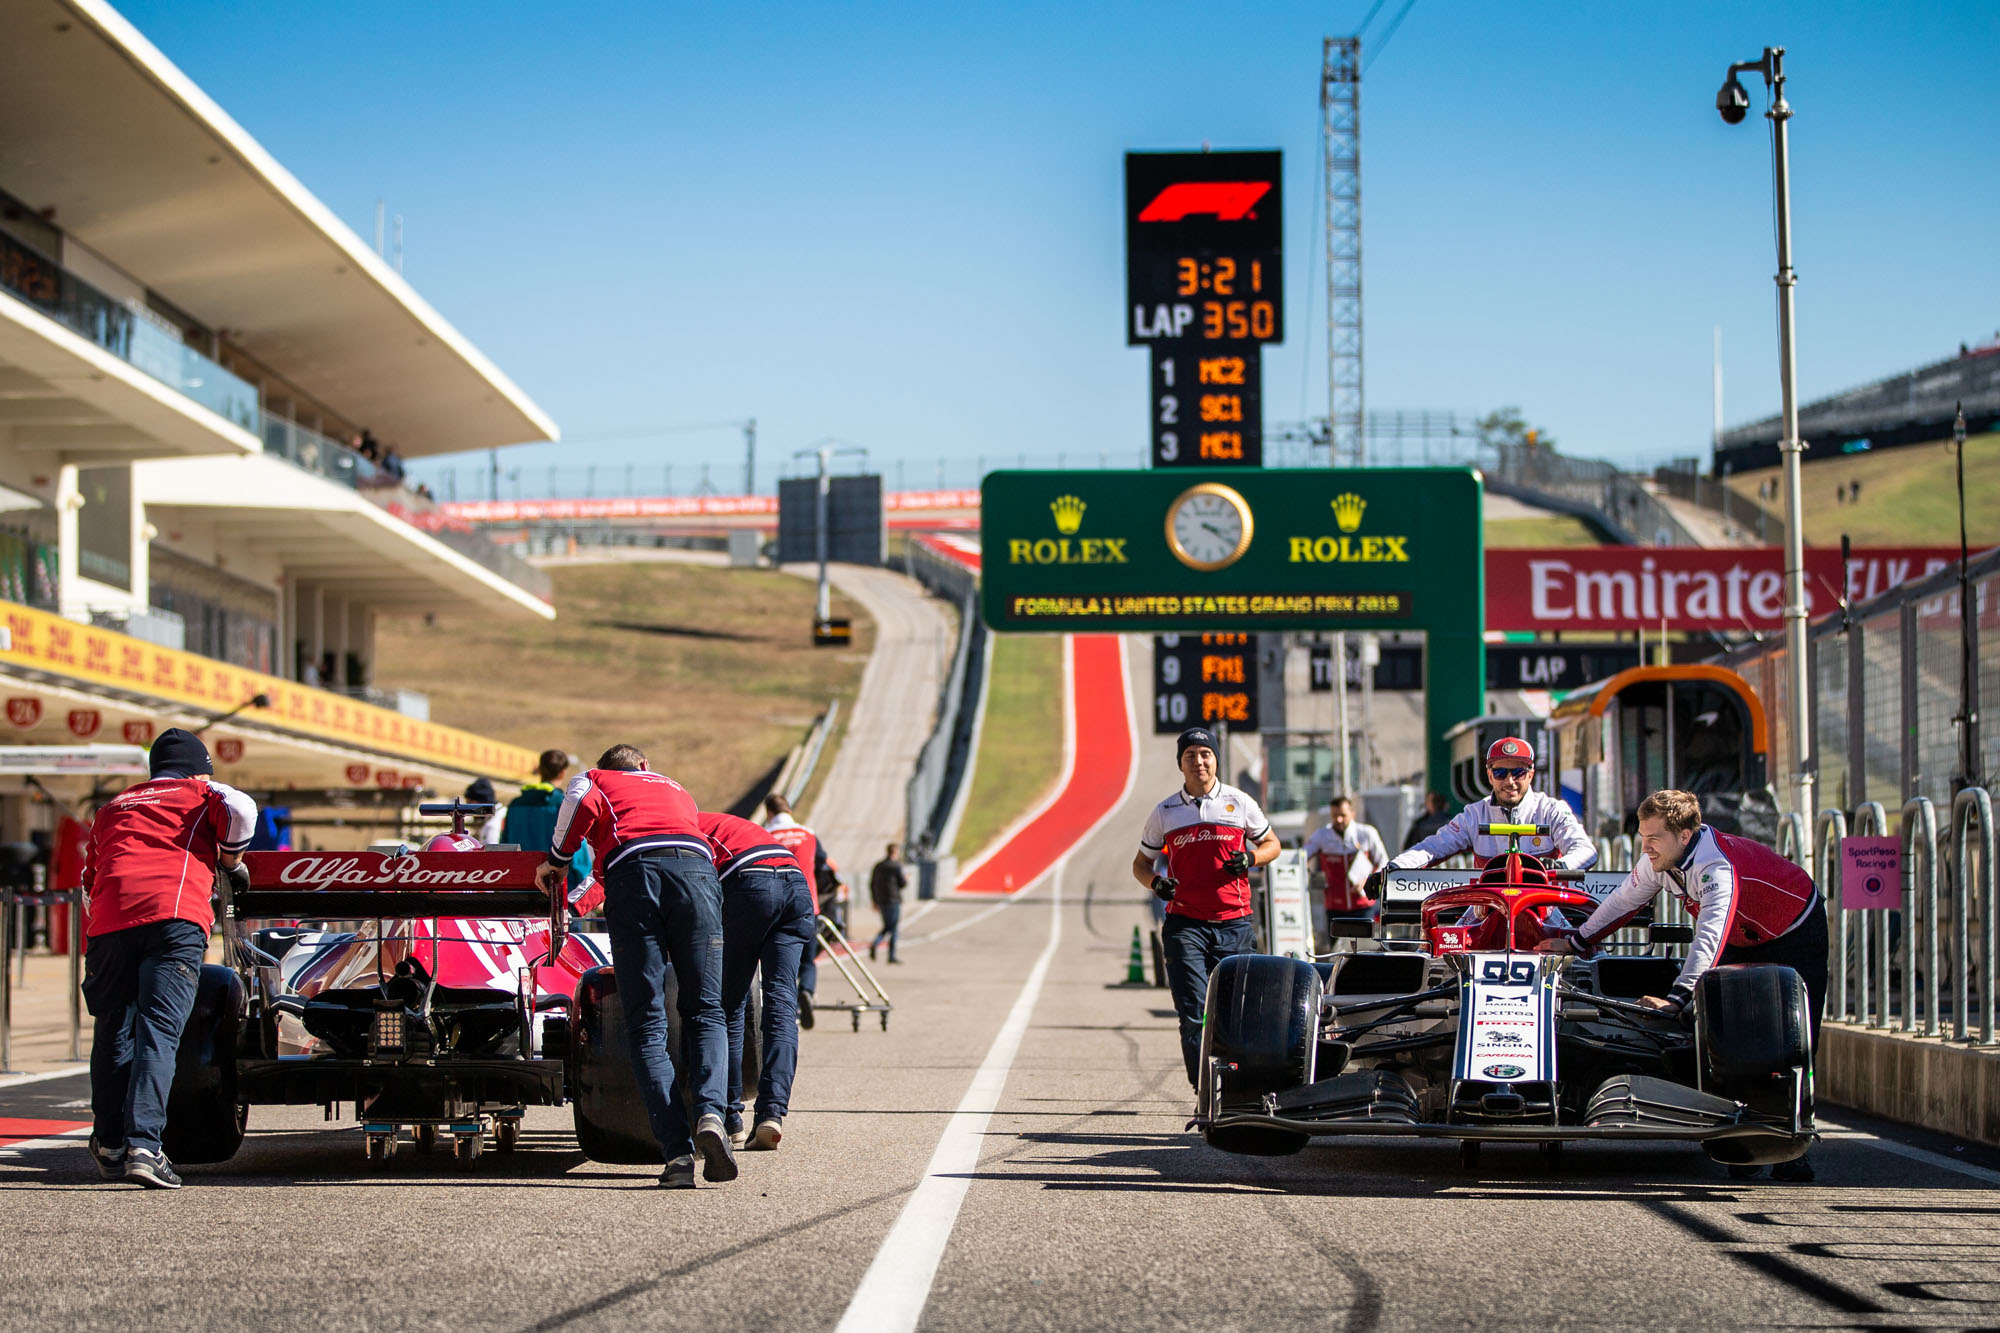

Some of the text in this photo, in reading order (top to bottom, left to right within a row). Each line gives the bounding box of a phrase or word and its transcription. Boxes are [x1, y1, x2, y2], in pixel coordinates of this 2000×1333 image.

[1134, 301, 1274, 339] LAP 350
[1160, 357, 1175, 386] 1
[1160, 395, 1178, 424] 2
[1161, 431, 1179, 461] 3
[1008, 538, 1128, 564] ROLEX
[1288, 536, 1409, 563] ROLEX
[1014, 598, 1100, 616] FORMULA
[1102, 598, 1113, 615] 1
[1115, 597, 1181, 615] UNITED
[1182, 596, 1248, 615] STATES
[1250, 595, 1313, 613] GRAND
[1315, 596, 1352, 612] PRIX
[1162, 655, 1181, 685] 9
[1520, 656, 1566, 683] LAP
[1157, 693, 1187, 723] 10
[1173, 829, 1236, 849] Alfa Romeo
[280, 854, 510, 891] Alfa Romeo
[1856, 860, 1886, 870] Racing
[1481, 961, 1536, 986] 99
